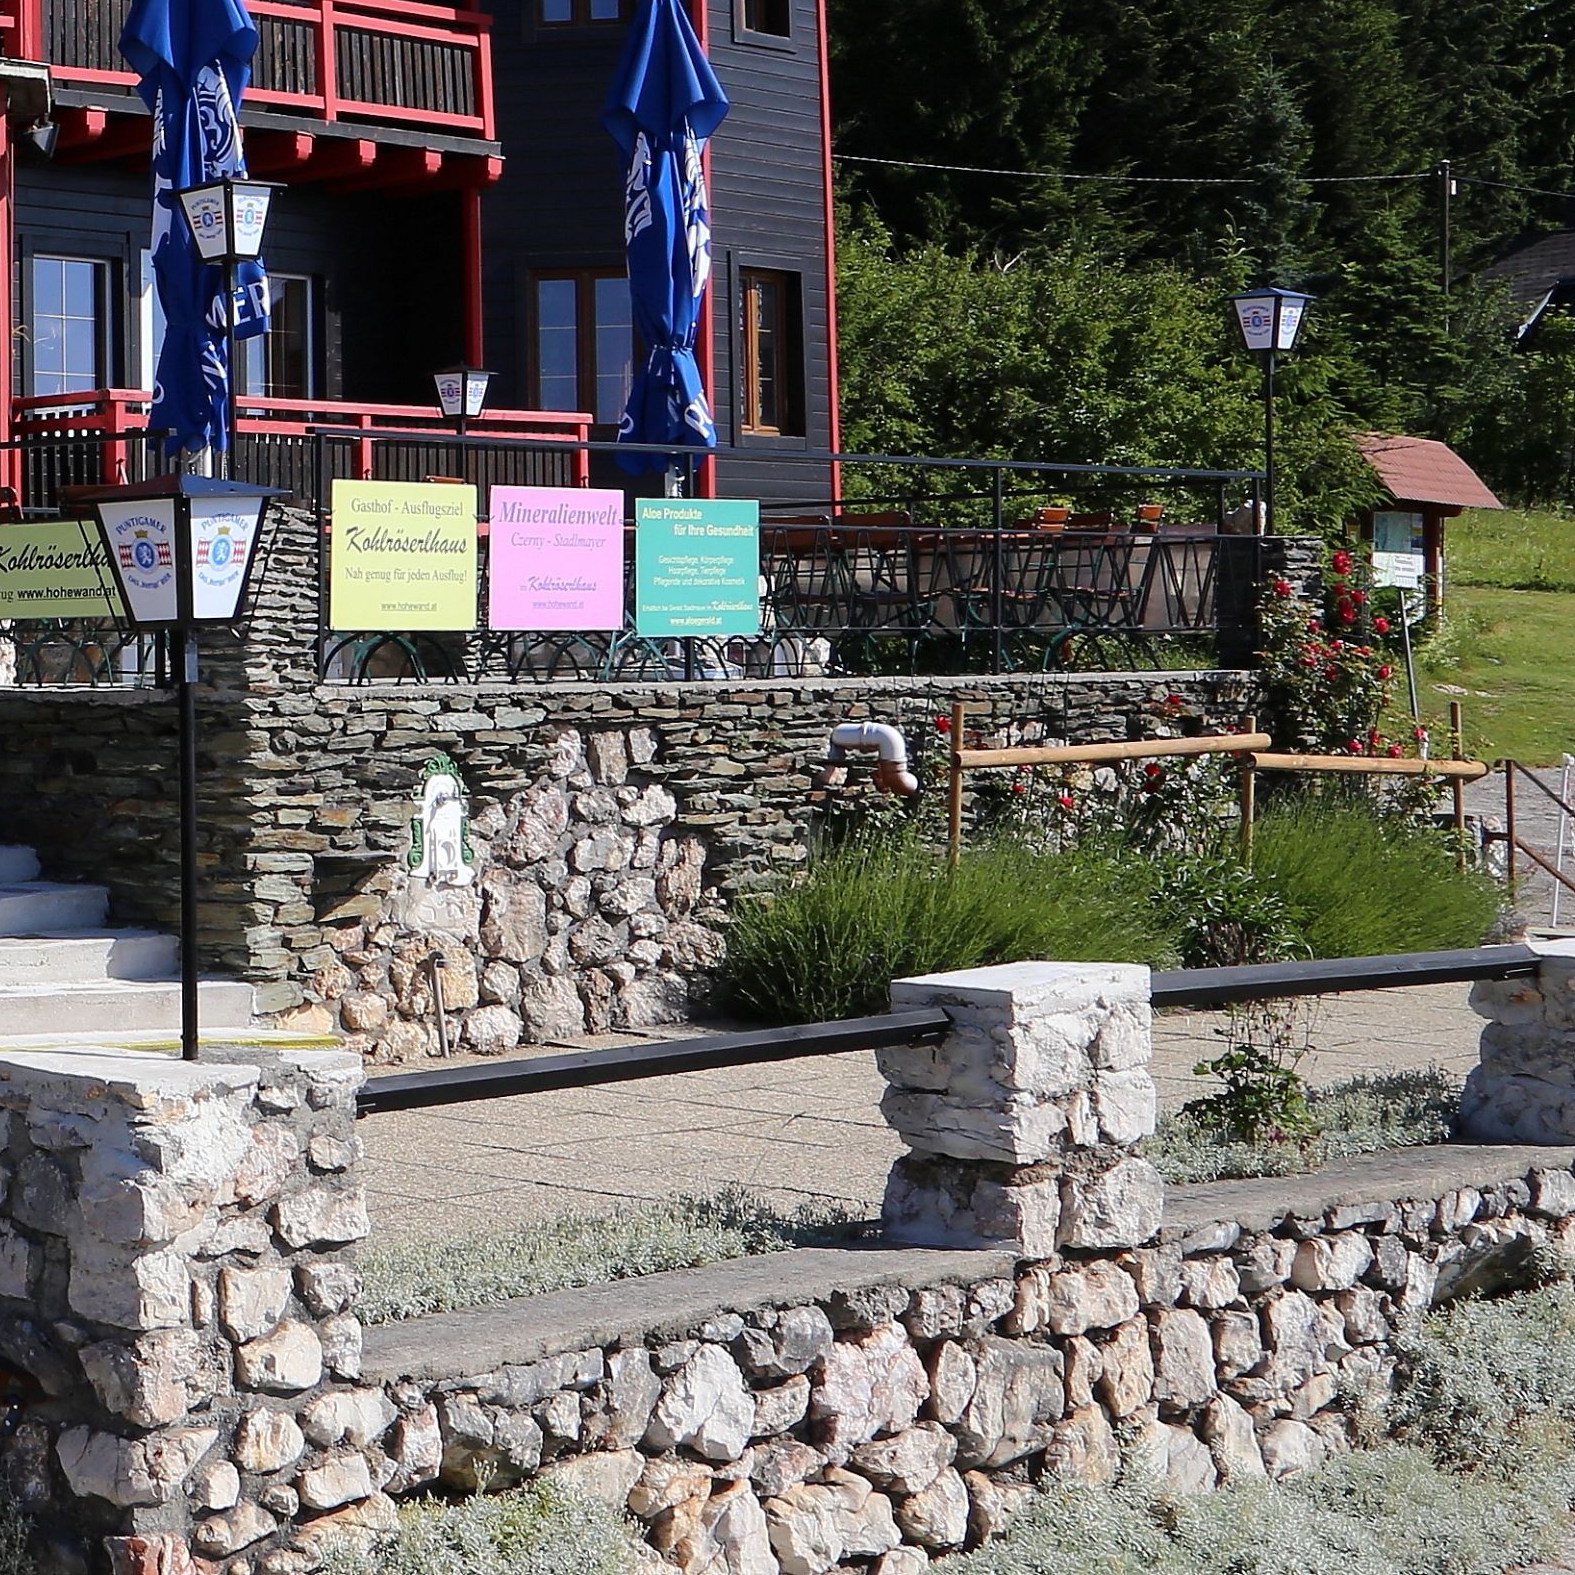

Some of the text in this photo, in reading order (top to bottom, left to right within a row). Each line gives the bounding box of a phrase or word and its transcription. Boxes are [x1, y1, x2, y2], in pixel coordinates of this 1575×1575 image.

[350, 498, 393, 514] Gasthof
[401, 500, 463, 519] Ausflugsziel
[499, 501, 618, 526] Mineralienwelt
[642, 507, 702, 520] Aloe Produkte
[115, 516, 167, 535] PUNTIGAMER
[201, 512, 248, 532] PUNTIGAMER
[673, 524, 754, 537] für Ihre Gesundheit
[345, 526, 468, 554] Kohlröserlhaus
[511, 532, 545, 550] Czerny
[553, 533, 606, 551] Stadlmayer
[345, 567, 468, 584] Nah genug für jeden Ausflug!
[17, 585, 116, 601] www.hohewand.at
